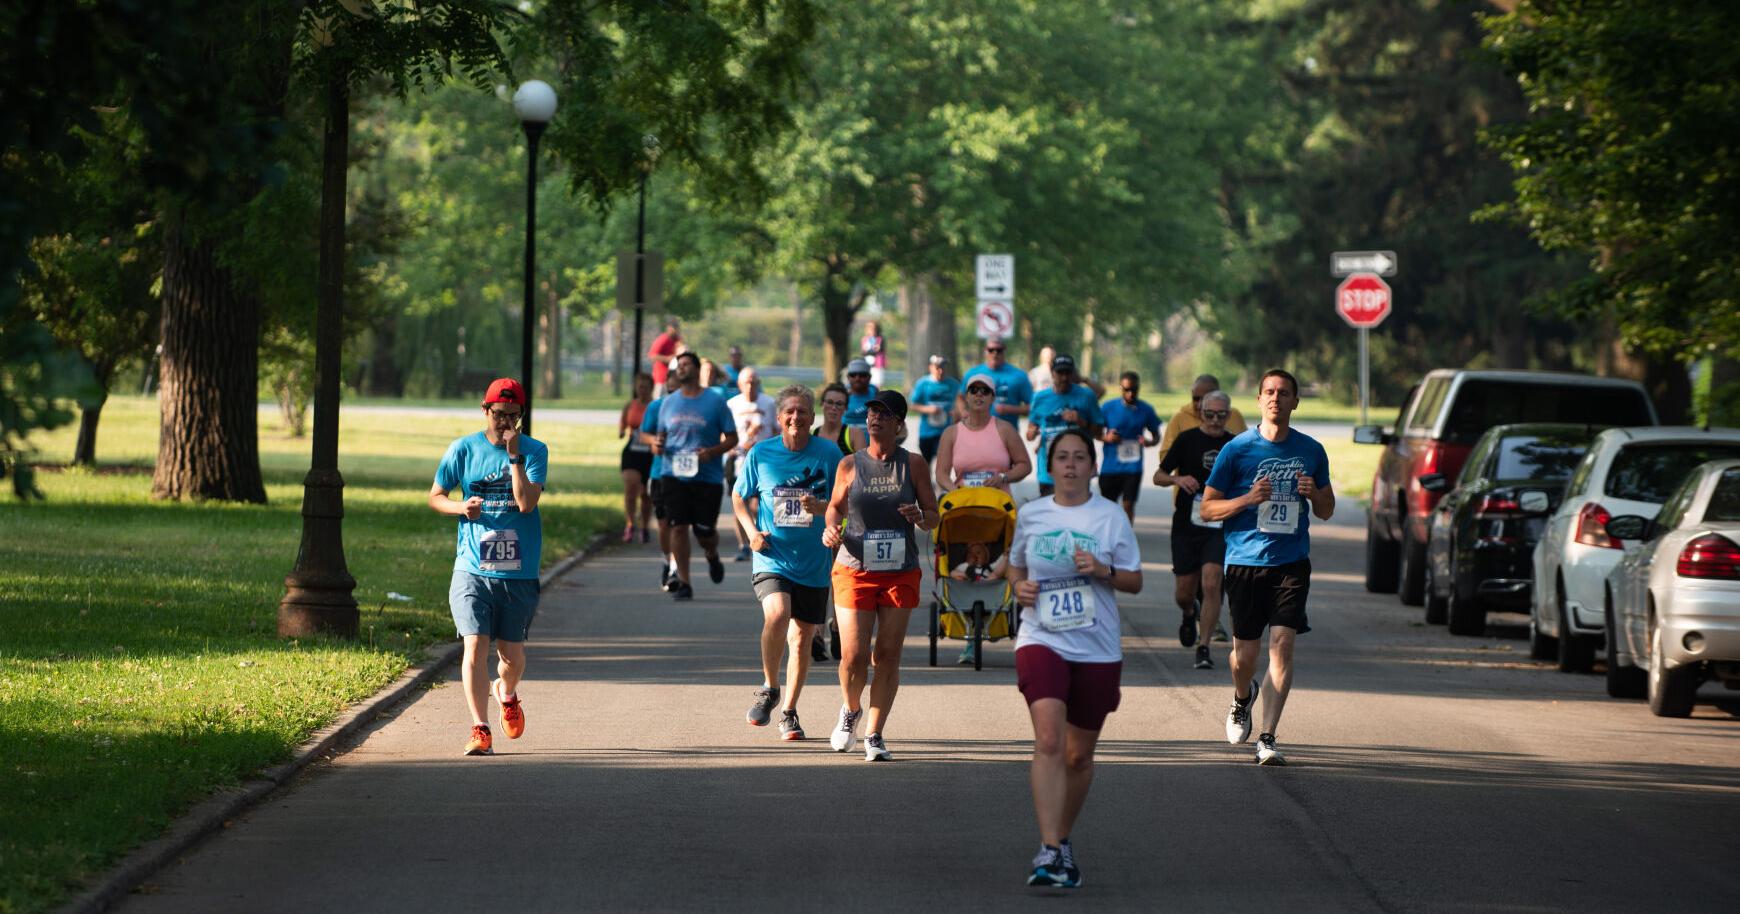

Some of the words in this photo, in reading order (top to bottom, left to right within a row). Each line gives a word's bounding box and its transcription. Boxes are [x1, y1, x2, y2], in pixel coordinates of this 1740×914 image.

[1343, 289, 1387, 311] STOP
[1271, 460, 1304, 470] Franklin
[863, 485, 903, 494] HAPPY
[870, 477, 895, 486] RUN
[785, 499, 801, 516] 98
[1271, 503, 1287, 522] 29
[485, 541, 516, 560] 795
[877, 541, 892, 560] 57
[1050, 591, 1084, 617] 248
